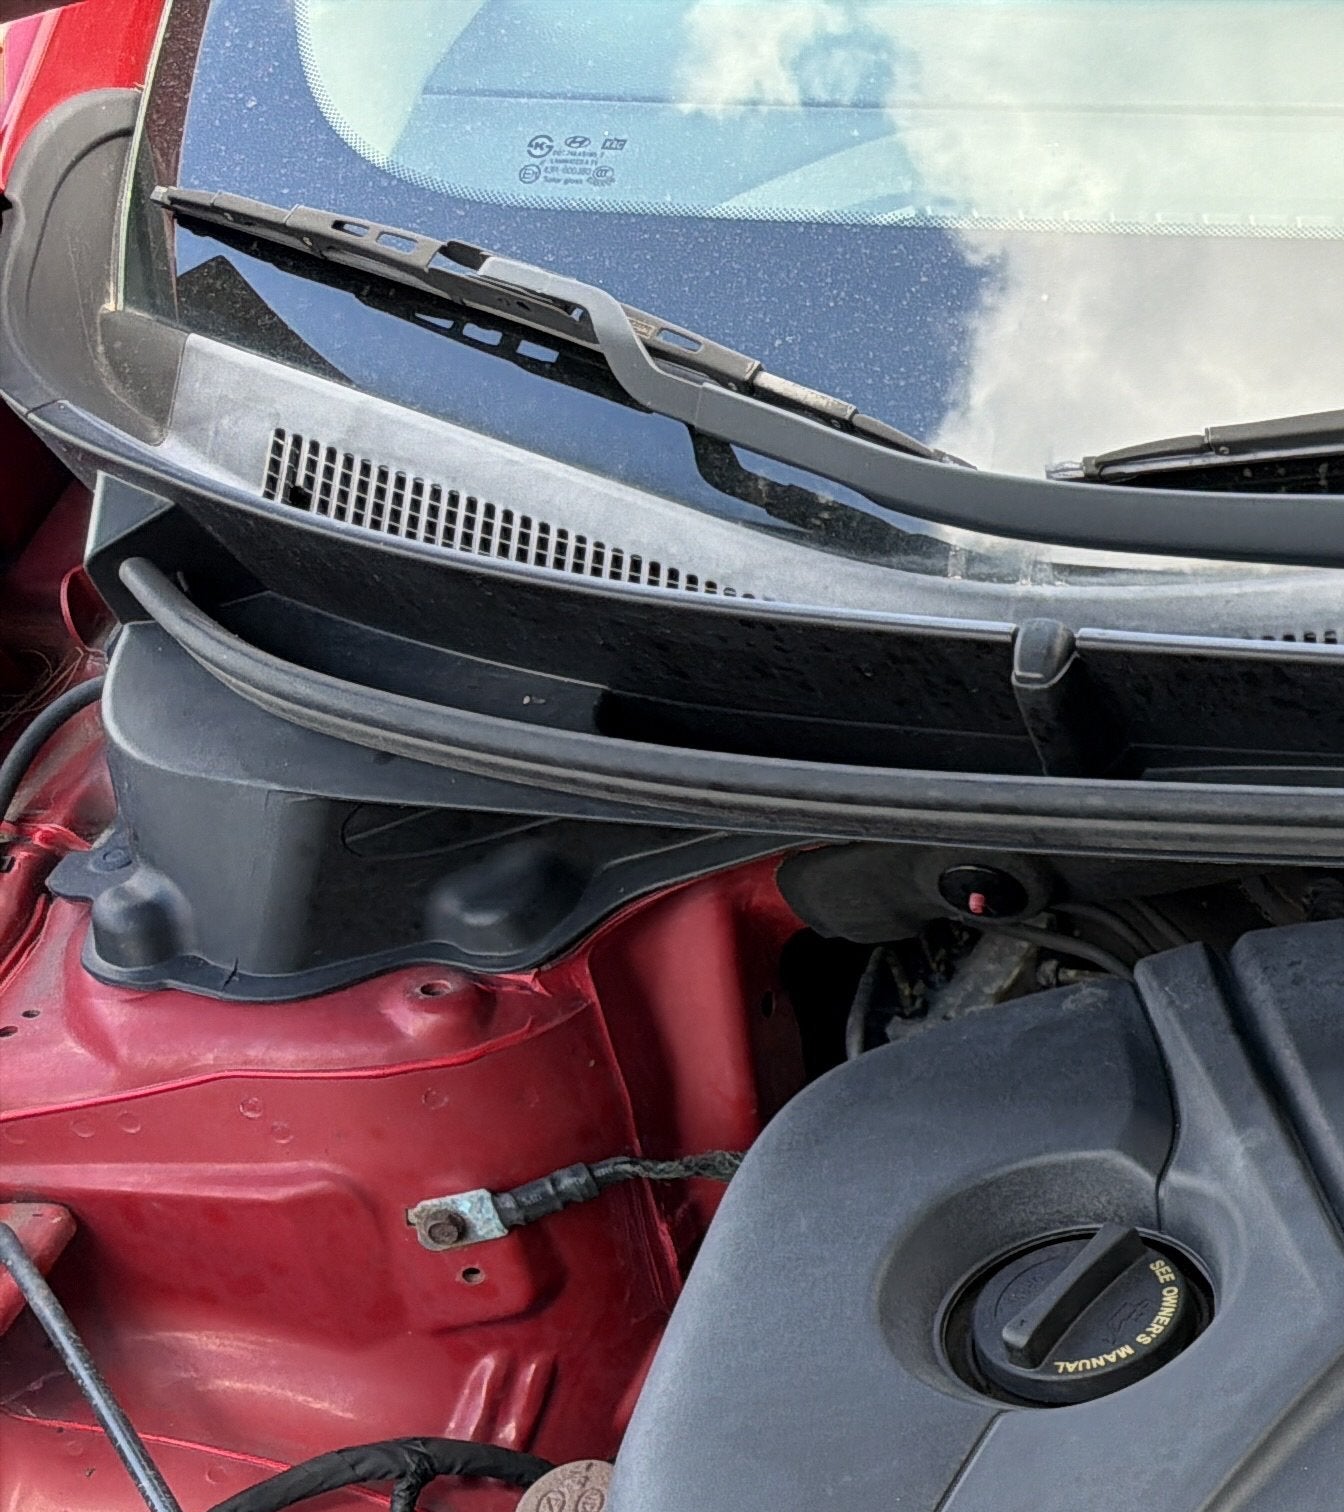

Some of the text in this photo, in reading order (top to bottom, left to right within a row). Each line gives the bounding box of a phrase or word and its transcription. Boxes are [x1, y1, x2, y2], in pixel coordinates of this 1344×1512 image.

[1053, 1259, 1179, 1374] SEE OWNER'S MANUAL
